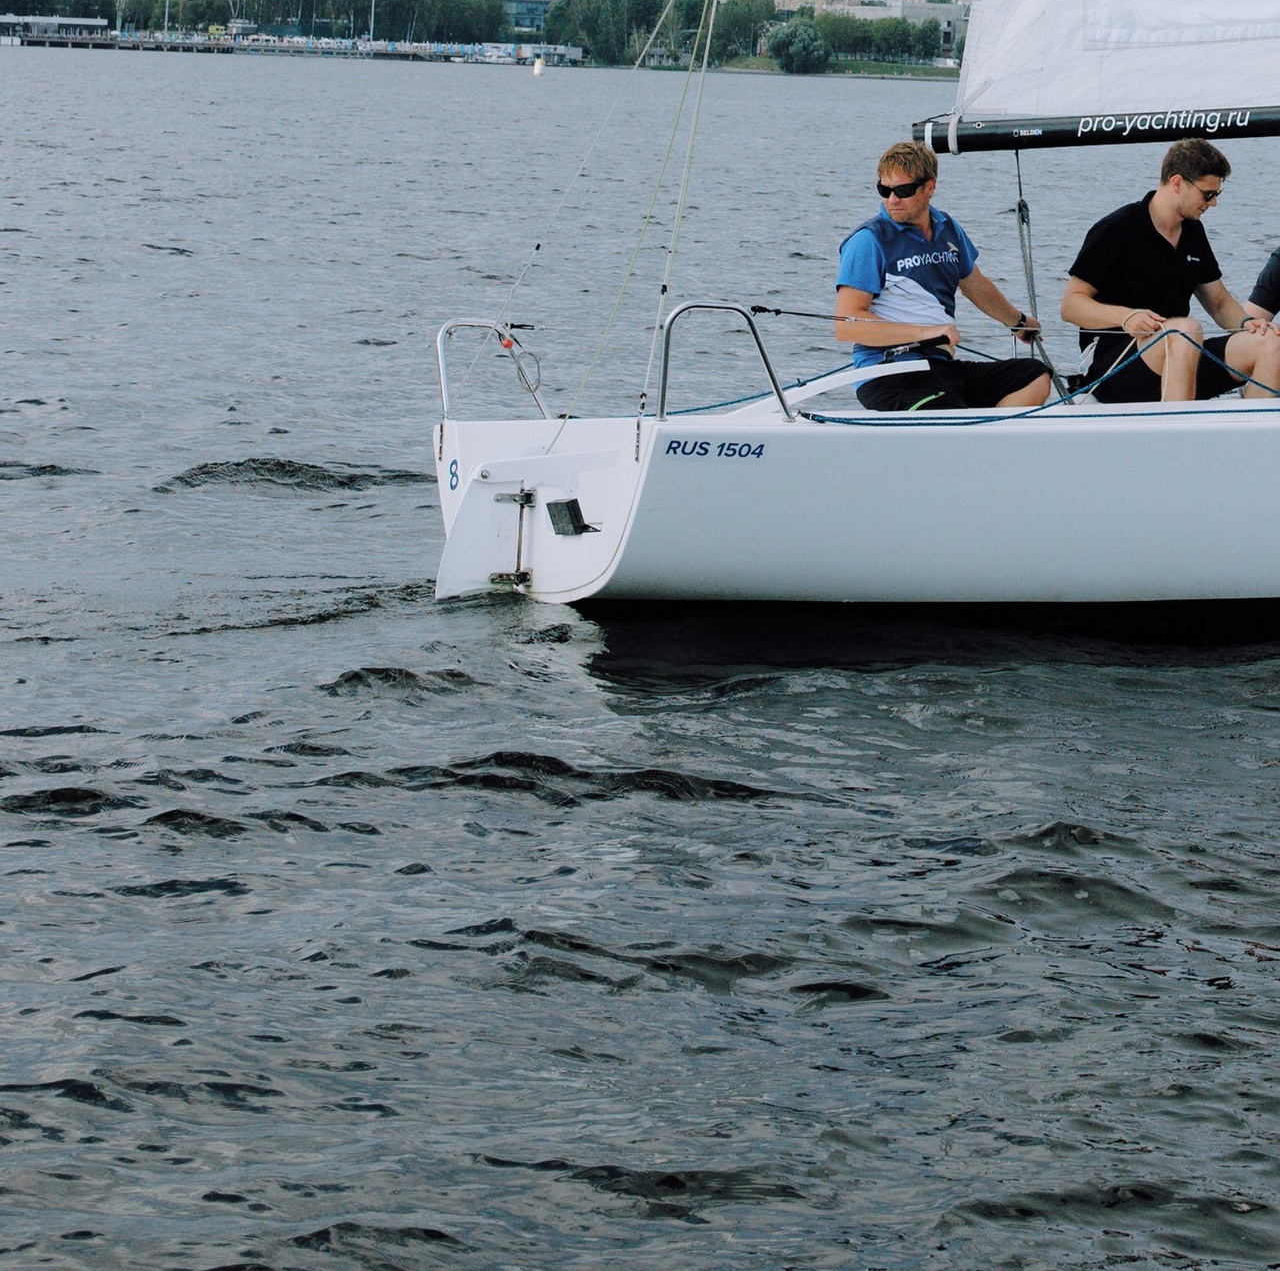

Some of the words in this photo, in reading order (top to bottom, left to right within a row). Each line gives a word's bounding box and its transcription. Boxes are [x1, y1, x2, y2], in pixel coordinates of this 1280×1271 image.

[1077, 110, 1251, 137] pro-yachting.ru
[665, 440, 712, 457] RUS
[716, 441, 765, 459] 1504
[449, 459, 459, 491] 8
